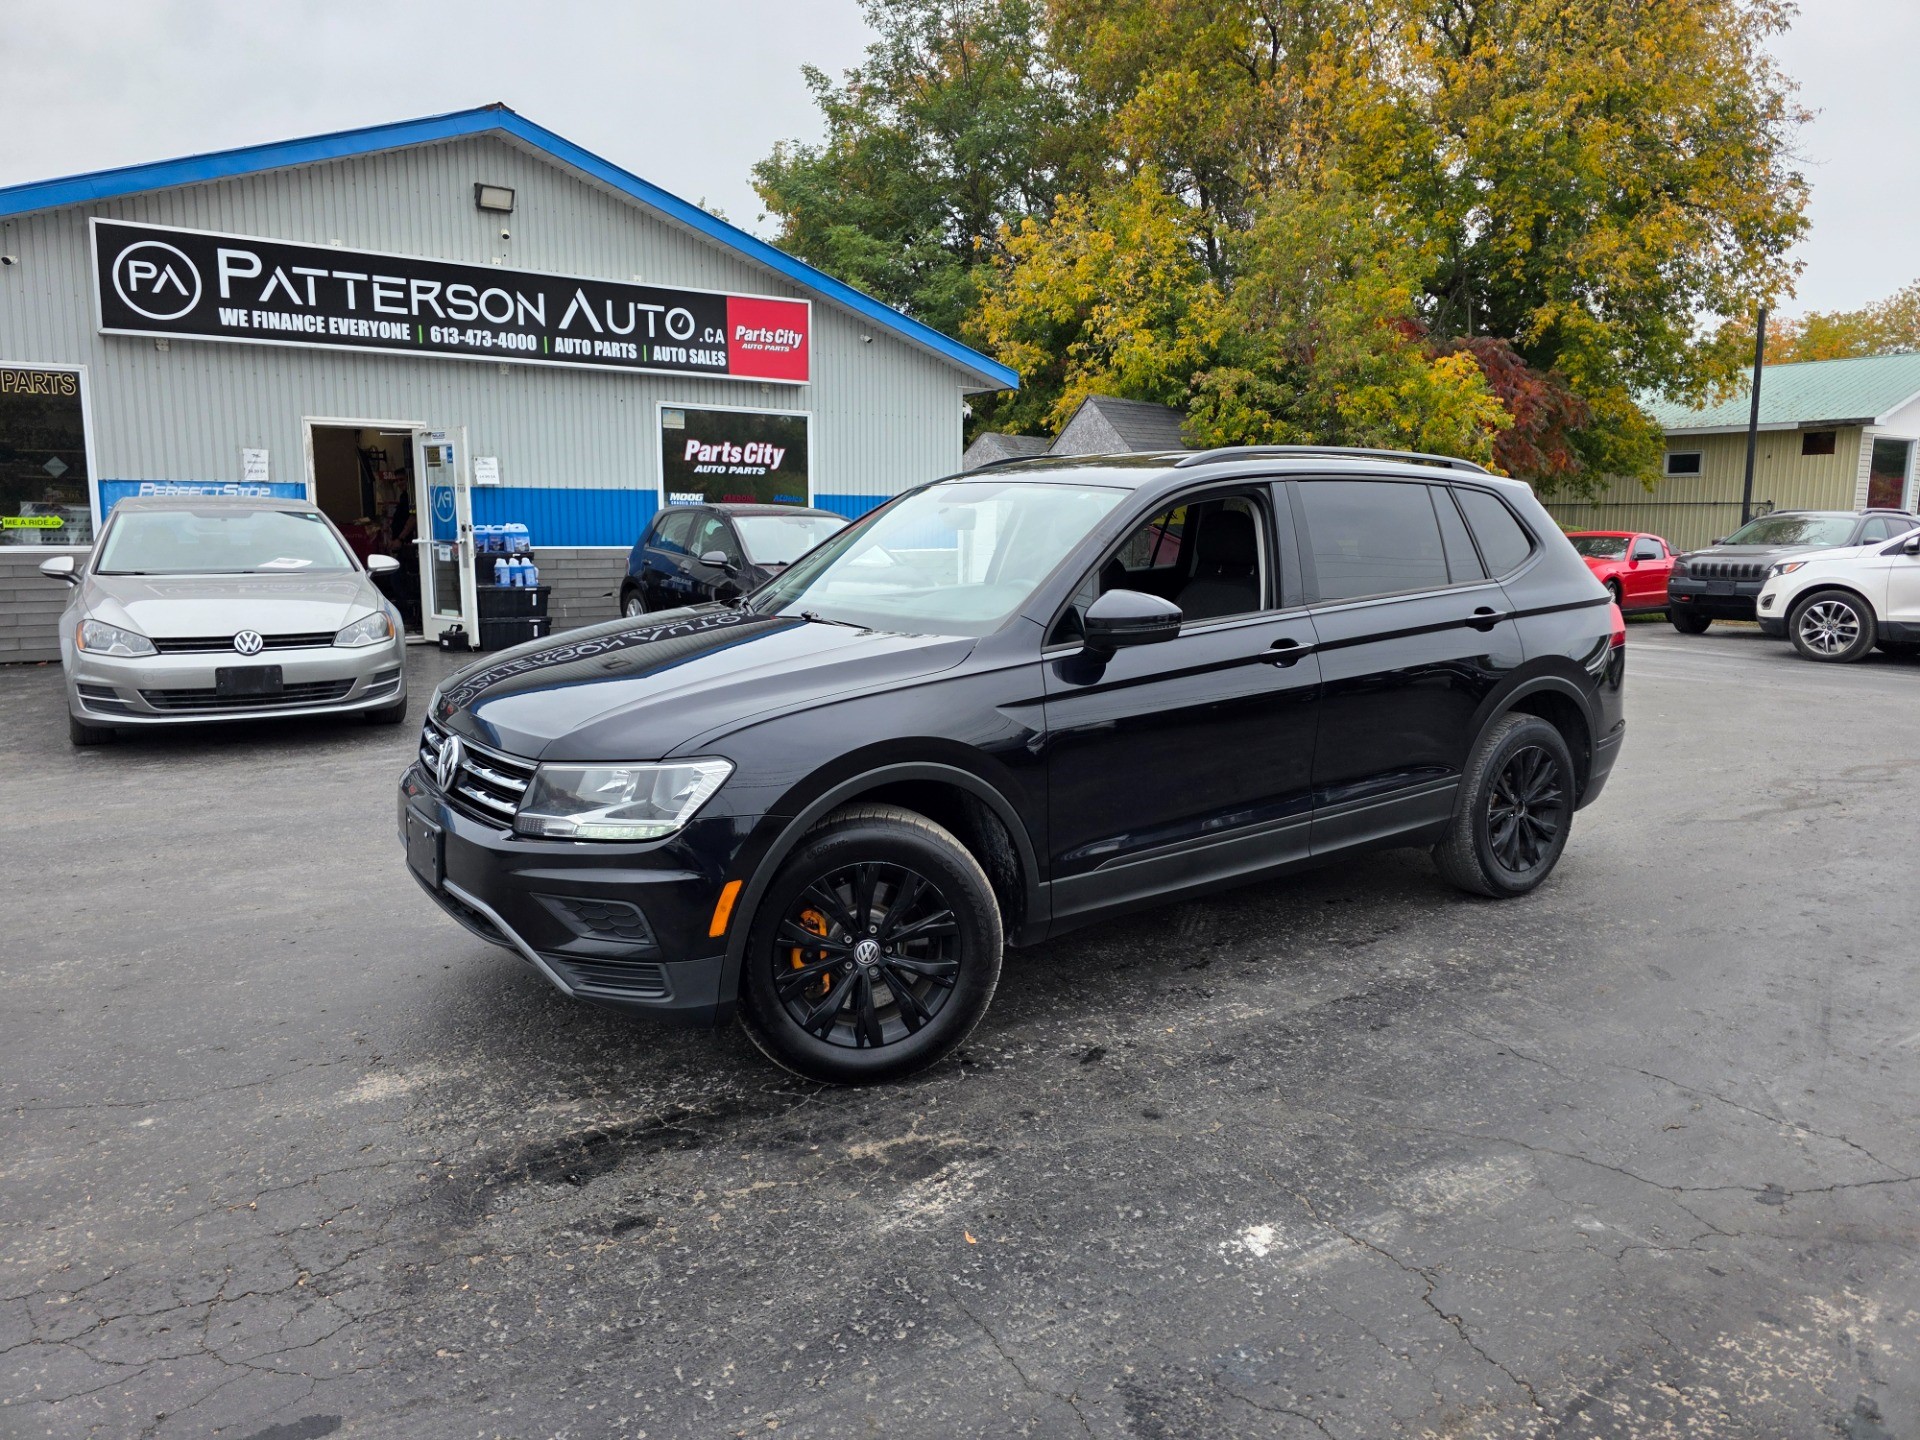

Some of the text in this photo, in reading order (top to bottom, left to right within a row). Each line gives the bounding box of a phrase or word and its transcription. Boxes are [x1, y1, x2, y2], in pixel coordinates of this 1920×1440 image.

[128, 260, 190, 296] PA
[217, 247, 546, 328] PATTERSON
[218, 308, 727, 367] WE FINANCE EVERYONE 613-473-4000 AUTO PARTS AUTO SALES
[741, 342, 790, 352] AUTO PARTS
[1, 369, 77, 396] PARTS
[694, 464, 766, 475] AUTO PARTS
[669, 492, 704, 501] MOOG
